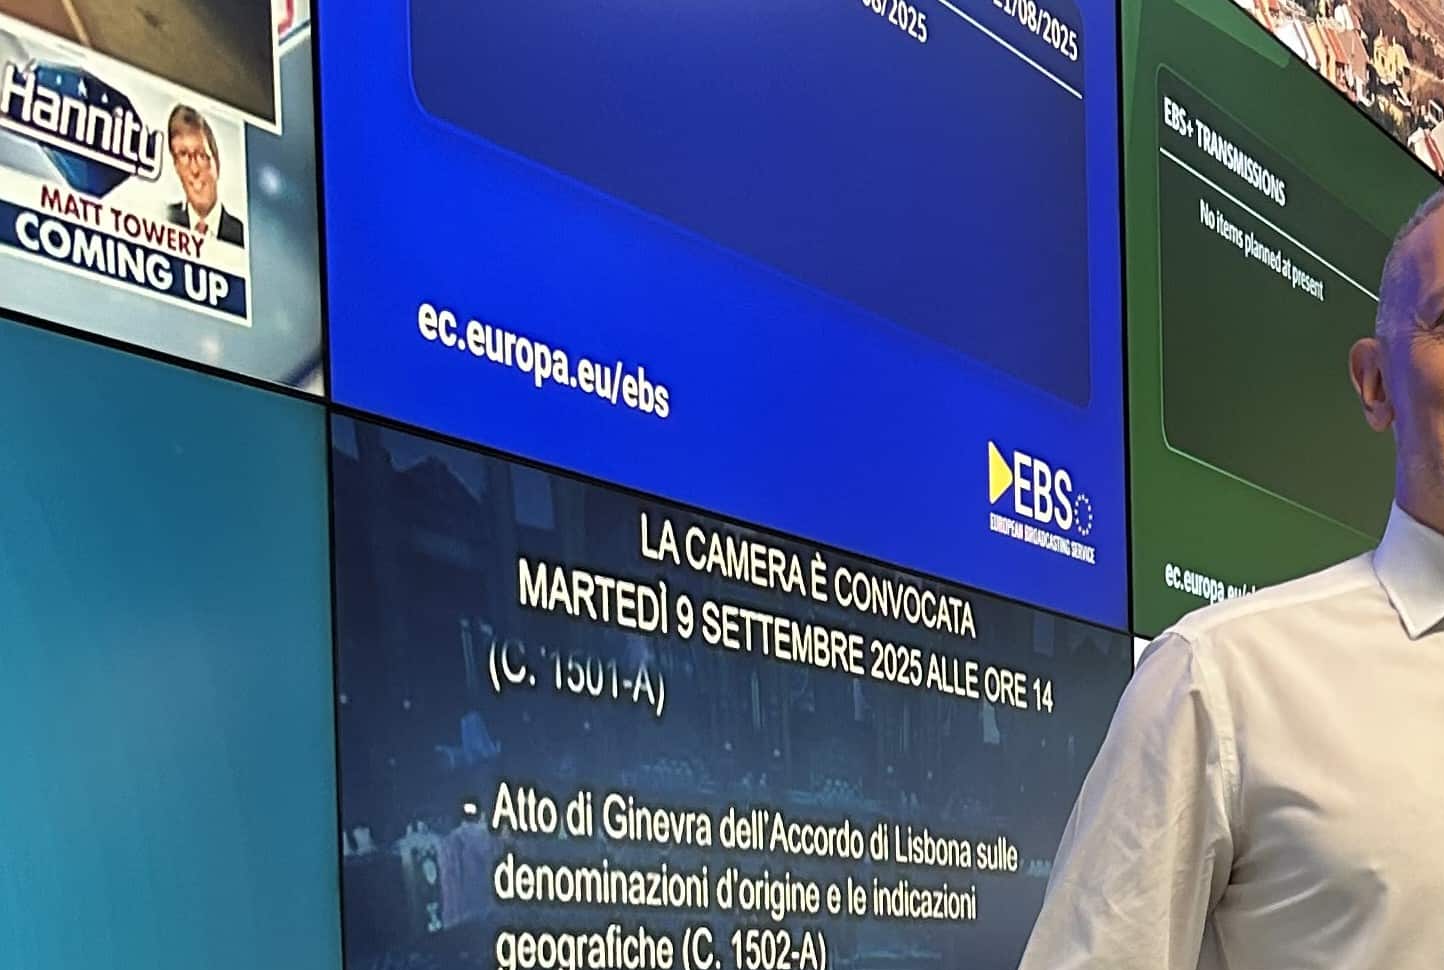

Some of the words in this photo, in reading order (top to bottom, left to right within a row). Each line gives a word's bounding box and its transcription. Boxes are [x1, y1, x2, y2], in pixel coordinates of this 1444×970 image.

[862, 0, 928, 43] /2025
[992, 0, 1078, 61] 1/08/2025
[0, 58, 164, 182] Hannity
[1164, 96, 1194, 138] EBS+
[1195, 119, 1286, 207] TRANSMISSIONS
[15, 211, 174, 290] COMING
[184, 263, 229, 306] UP
[41, 185, 103, 226] MATT
[110, 207, 205, 259] TOWERY
[1200, 199, 1215, 230] No
[1216, 210, 1244, 249] items
[1245, 232, 1281, 274] planned
[1282, 258, 1292, 282] at
[1292, 266, 1324, 301] present
[418, 303, 670, 418] ec.europa.eu/ebs
[1013, 450, 1073, 530] EBS
[641, 512, 681, 565] LA
[685, 526, 806, 596] CAMERA
[811, 551, 828, 602] È
[835, 567, 977, 639] CONVOCATA
[489, 640, 536, 692] (C.
[519, 557, 668, 634] MARTEDÌ
[676, 594, 695, 640] 9
[702, 600, 865, 675] SETTEMBRE
[870, 640, 923, 686] 2025
[926, 654, 980, 699] ALLE
[984, 666, 1028, 710] ORE
[1033, 677, 1054, 713] 14
[492, 782, 558, 833] Atto
[566, 790, 594, 838] di
[603, 793, 712, 847] Ginevra
[719, 807, 864, 860] dell'Accordo
[870, 823, 889, 861] di
[895, 824, 972, 869] Lisbona
[976, 836, 1018, 873] sulle
[494, 853, 709, 908] denominazioni
[716, 867, 820, 922] d'origine
[827, 883, 841, 913] e
[847, 876, 867, 915] le
[873, 878, 977, 919] indicazioni
